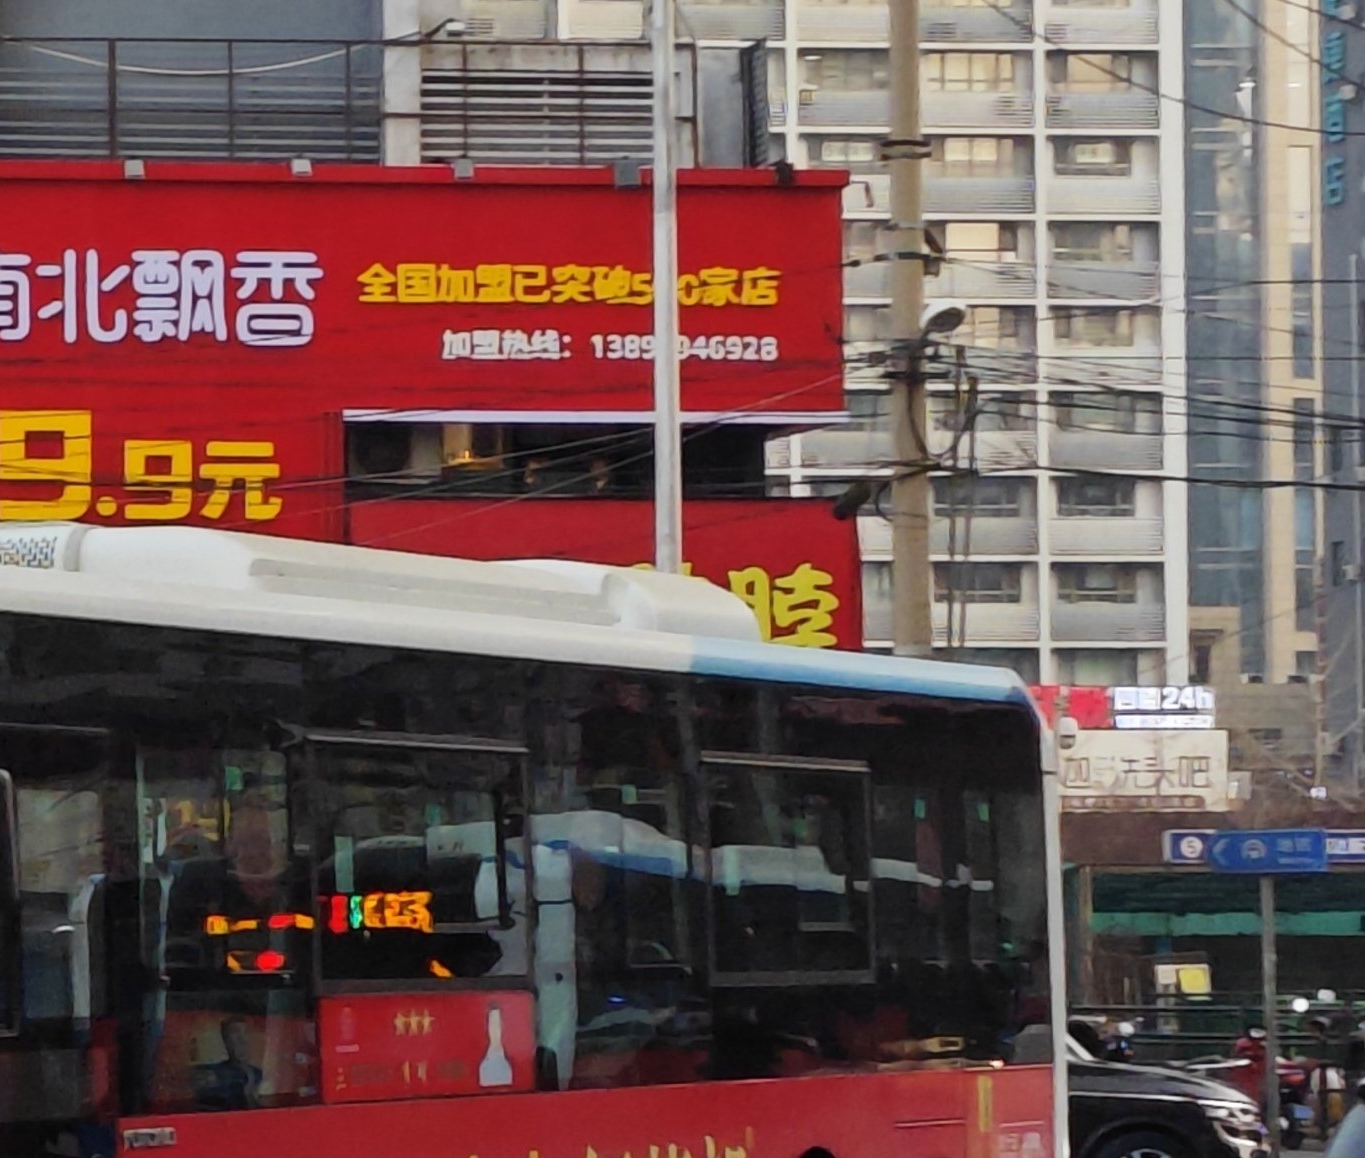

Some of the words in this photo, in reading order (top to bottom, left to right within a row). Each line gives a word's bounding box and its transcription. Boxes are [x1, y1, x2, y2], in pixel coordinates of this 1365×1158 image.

[356, 263, 783, 305] 全国加盟已突破50家店
[590, 335, 779, 361] 138946928
